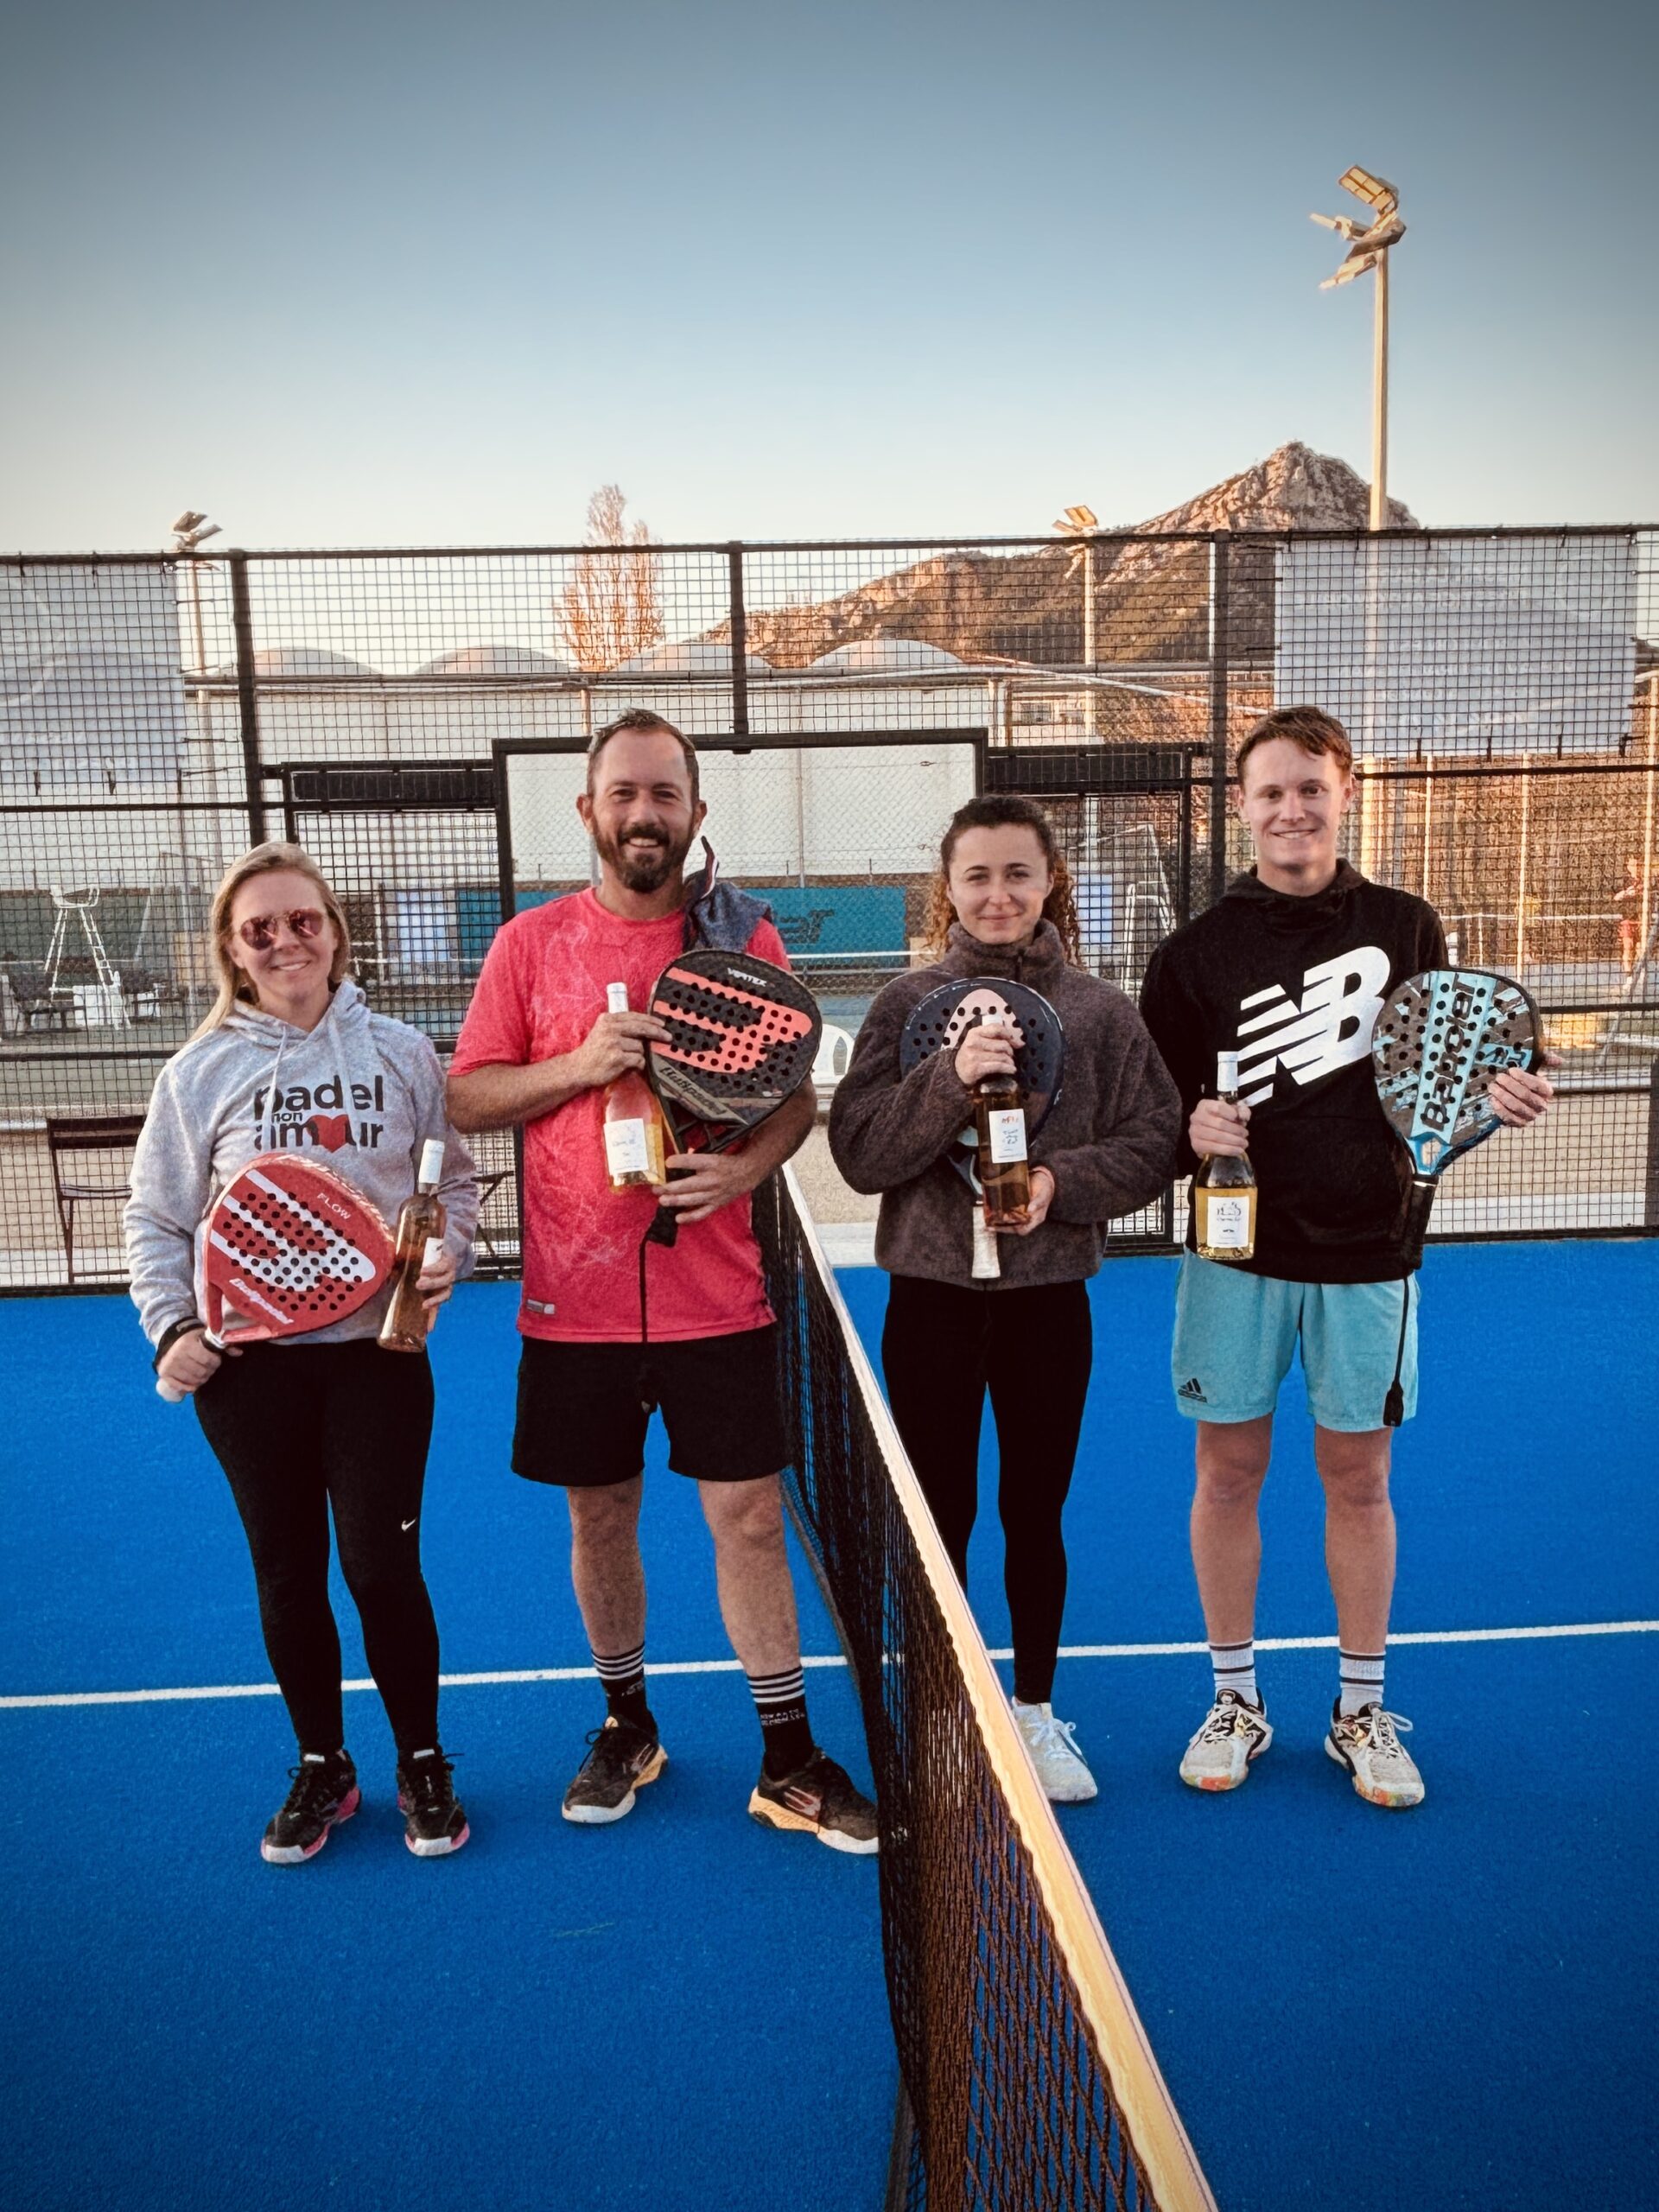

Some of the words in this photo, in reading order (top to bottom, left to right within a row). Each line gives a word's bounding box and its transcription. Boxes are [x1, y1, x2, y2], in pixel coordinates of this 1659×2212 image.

[1237, 946, 1390, 1107] NB
[255, 1075, 384, 1121] padel
[317, 1192, 352, 1219] FLOW
